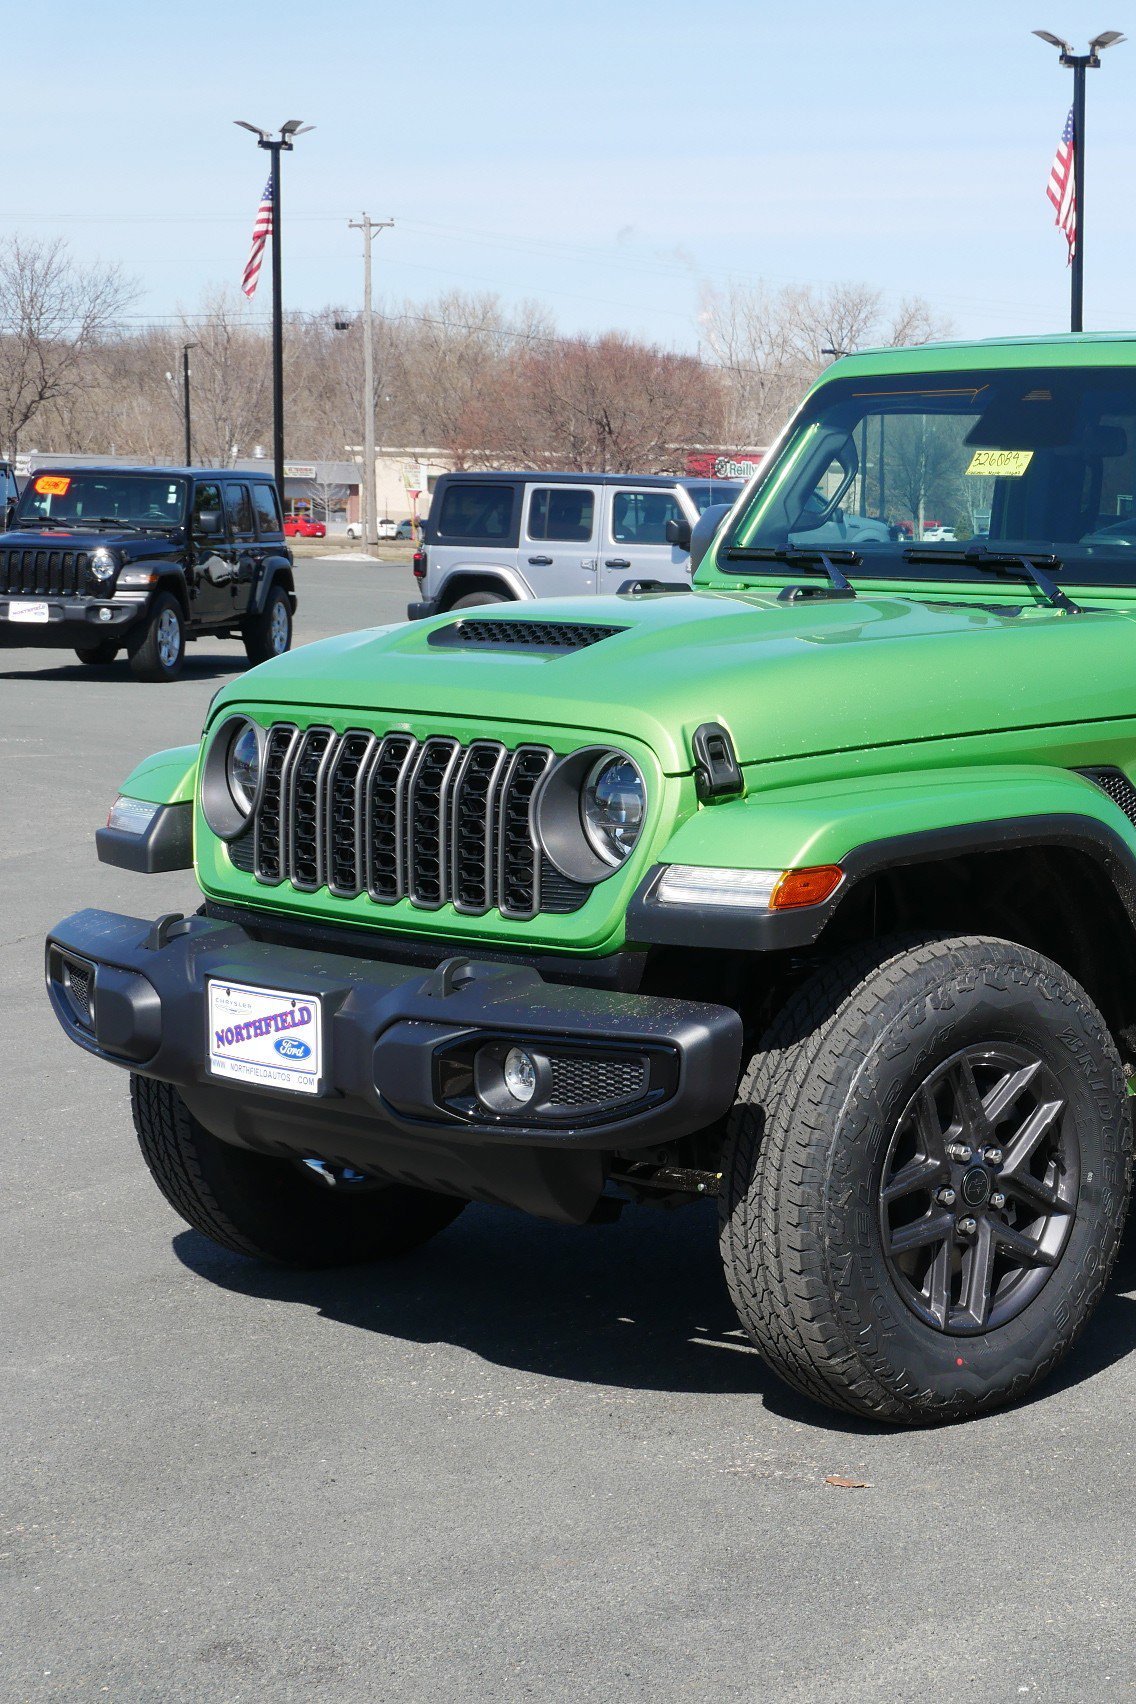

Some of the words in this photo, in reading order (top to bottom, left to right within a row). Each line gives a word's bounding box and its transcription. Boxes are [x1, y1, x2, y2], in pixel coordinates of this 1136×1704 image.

[215, 997, 252, 1009] CHRYSLER
[214, 1005, 312, 1049] NORTHFIELD
[279, 1039, 305, 1057] Ford
